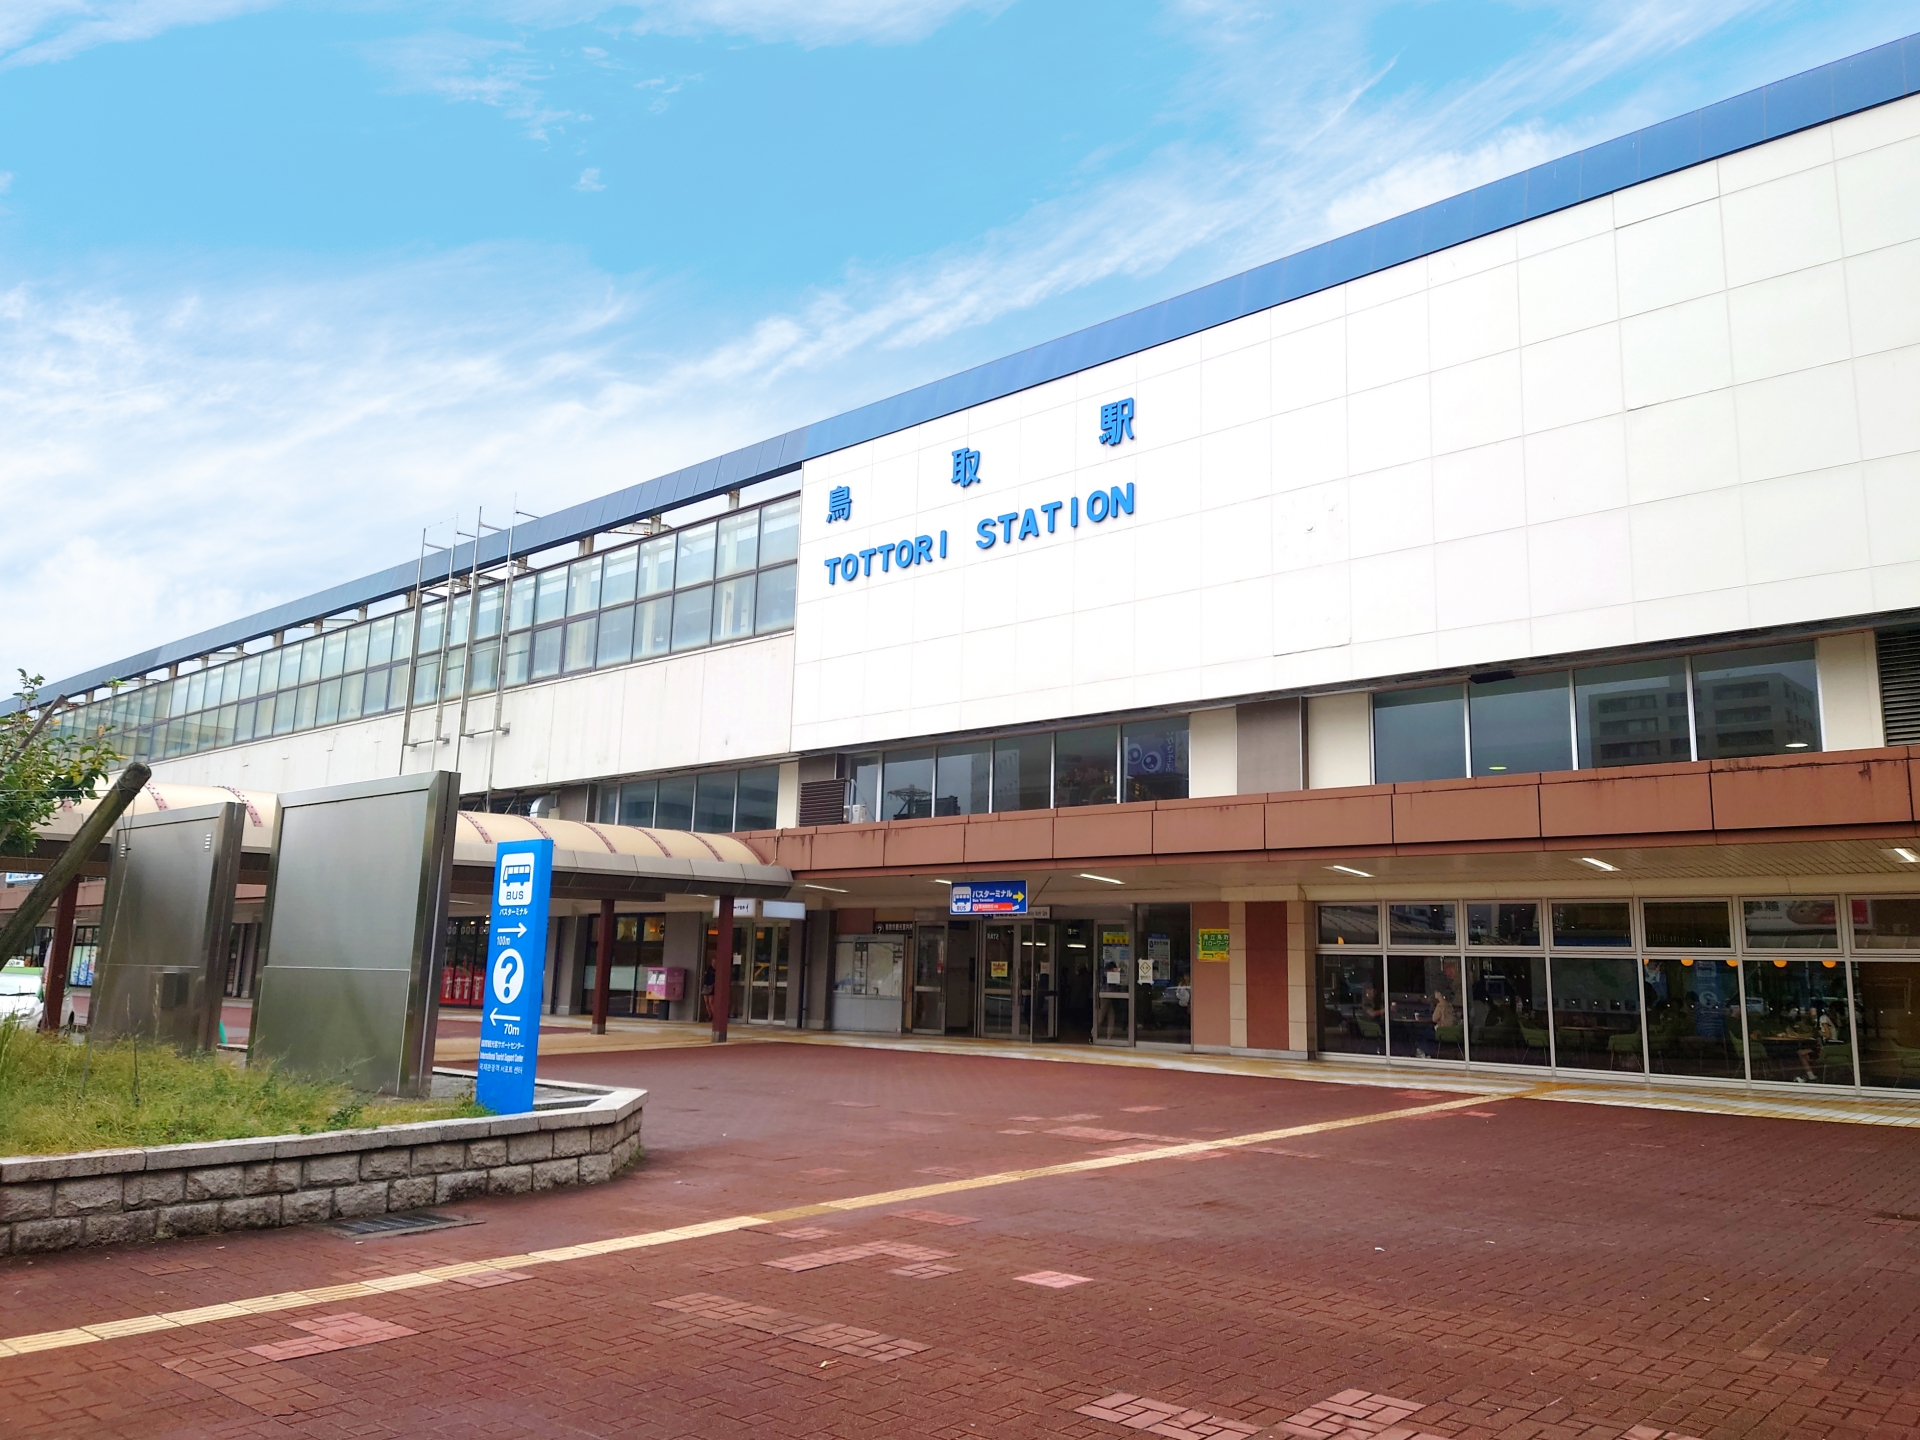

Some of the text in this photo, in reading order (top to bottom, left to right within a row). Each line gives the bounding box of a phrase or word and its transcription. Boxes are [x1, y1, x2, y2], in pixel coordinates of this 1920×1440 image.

[824, 482, 1135, 586] TOTTORI STATION
[506, 890, 524, 900] BUS
[972, 889, 1013, 899] バスターミナル
[499, 907, 529, 916] バスターミナル
[503, 1023, 520, 1036] 70m
